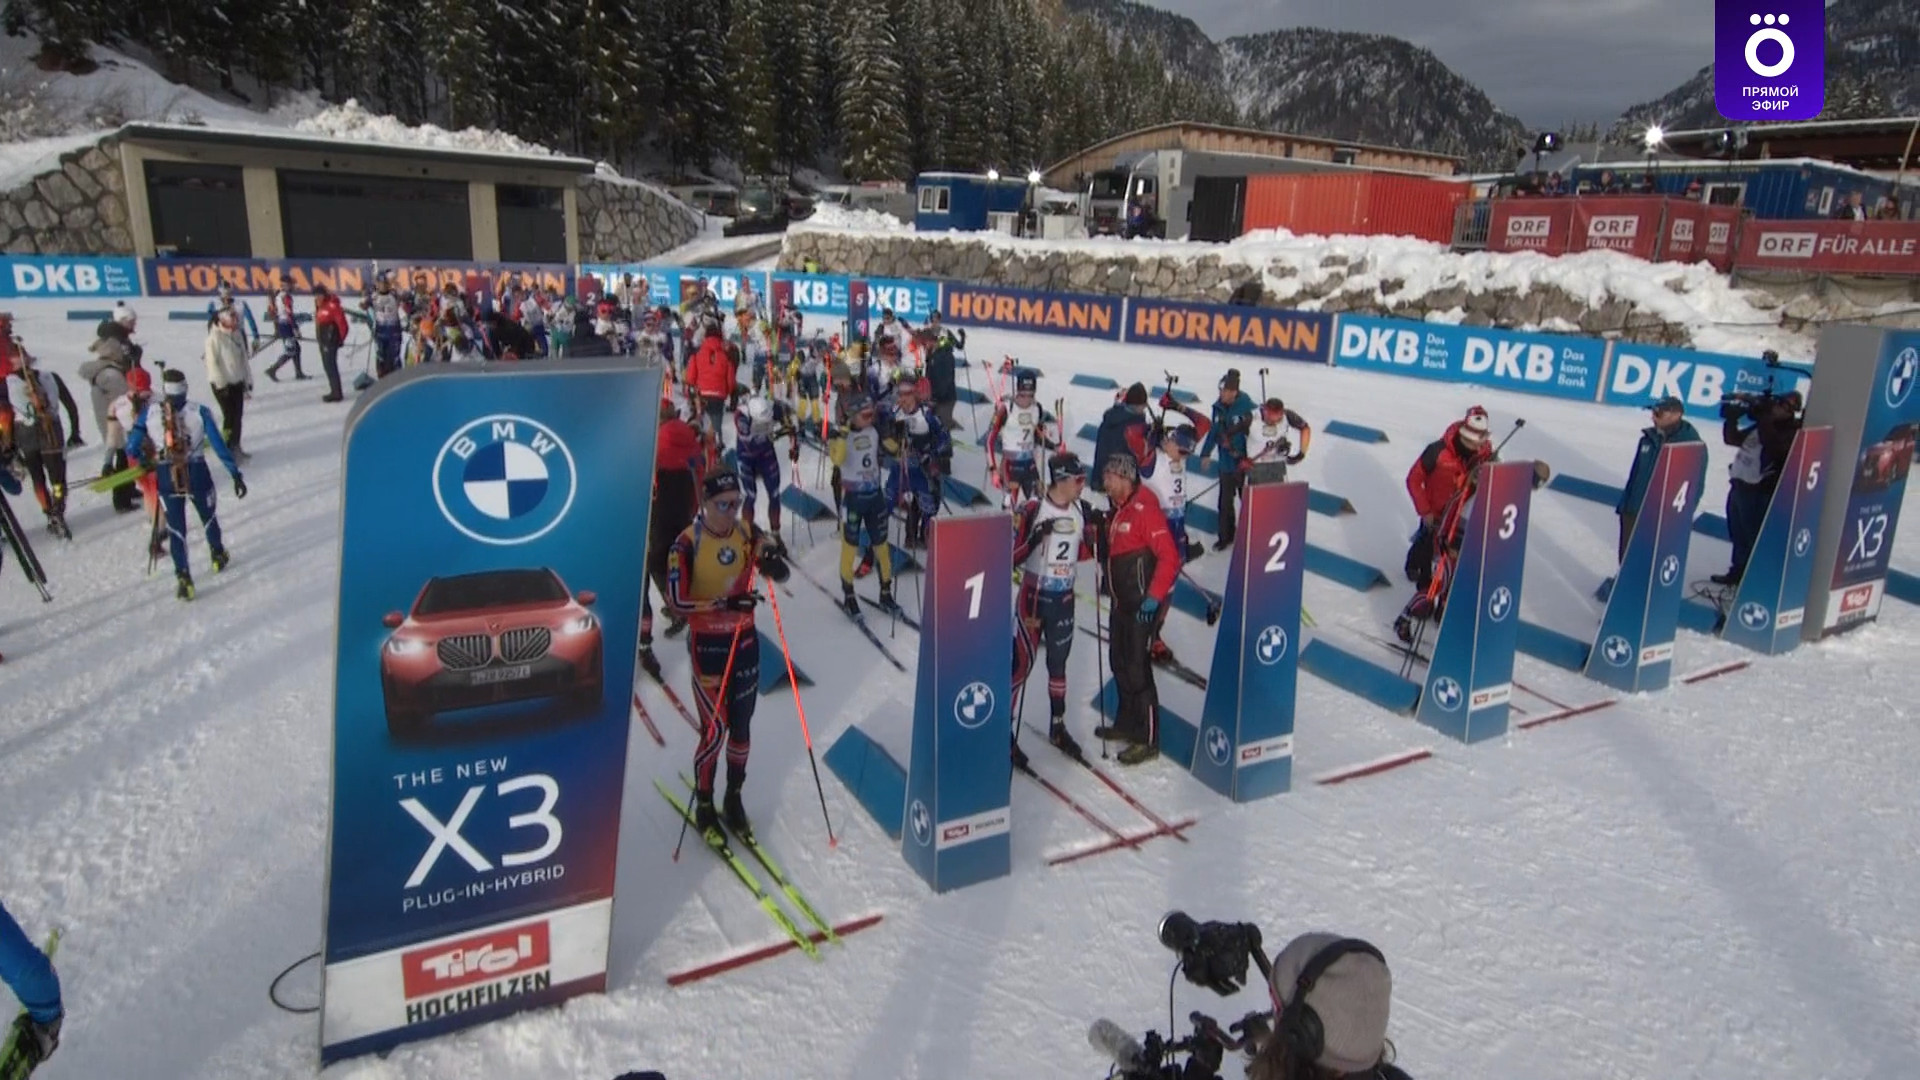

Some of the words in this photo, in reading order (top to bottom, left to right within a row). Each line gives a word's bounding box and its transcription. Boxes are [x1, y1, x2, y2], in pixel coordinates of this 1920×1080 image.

[1511, 219, 1548, 233] ORF
[1593, 219, 1635, 234] ORF
[1763, 237, 1812, 253] ORF
[1818, 233, 1859, 254] FÜR
[1860, 238, 1917, 256] ALLE
[12, 263, 101, 292] DKB
[156, 263, 363, 292] HÖRMANN
[586, 292, 596, 305] 2
[949, 291, 1112, 332] HÖRMANN
[1134, 306, 1320, 354] HÖRMANN
[1339, 324, 1420, 366] DKB
[1426, 333, 1446, 346] Das
[1422, 357, 1448, 370] Bank
[1424, 346, 1449, 358] kann
[1461, 336, 1555, 383] DKB
[1562, 347, 1585, 362] Das
[1558, 375, 1586, 389] Bank
[1560, 361, 1588, 376] kann
[1611, 353, 1726, 407] DKB
[1735, 369, 1764, 386] Das
[451, 420, 557, 460] BMW
[1022, 428, 1031, 441] 7
[861, 452, 872, 468] 6
[1173, 478, 1183, 495] 3
[1805, 461, 1821, 492] 5
[1672, 480, 1690, 513] 4
[1498, 503, 1518, 540] 3
[1056, 540, 1070, 560] 2
[1263, 530, 1290, 573] 2
[1848, 513, 1889, 562] X3
[964, 570, 986, 620] 1
[394, 766, 443, 790] THE
[457, 755, 508, 779] NEW
[398, 773, 563, 890] X3
[403, 864, 566, 913] PLUG-IN-HYBRID
[421, 934, 533, 979] Tirol
[406, 971, 552, 1025] HOCHFILZEN
